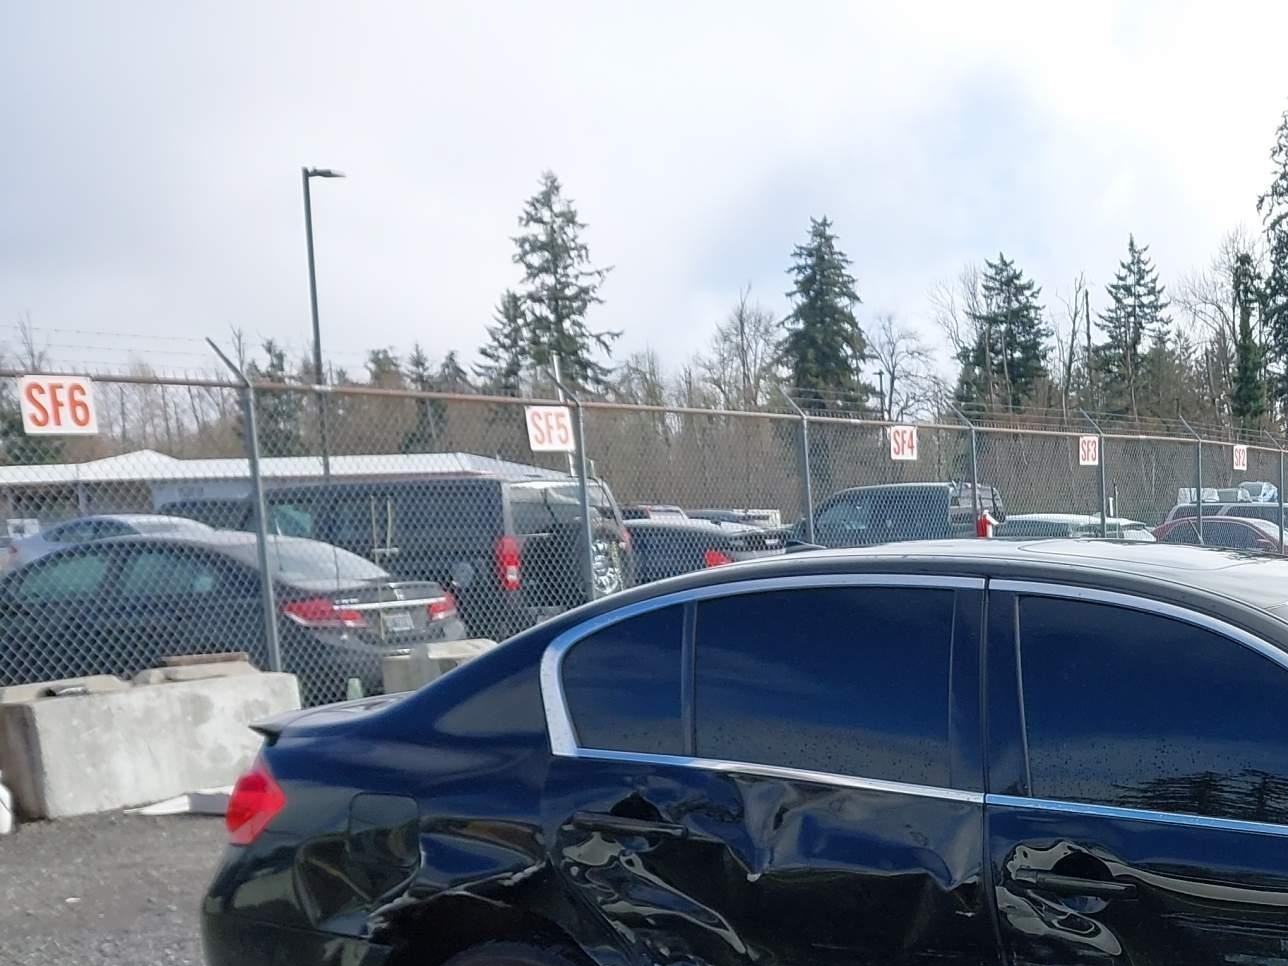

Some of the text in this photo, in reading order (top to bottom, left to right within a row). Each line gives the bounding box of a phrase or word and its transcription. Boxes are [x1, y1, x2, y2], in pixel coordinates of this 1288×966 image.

[25, 382, 90, 427] SF6
[531, 411, 569, 445] SF5
[893, 430, 915, 456] SF4
[1081, 439, 1097, 462] SF3
[1234, 447, 1246, 467] SF2
